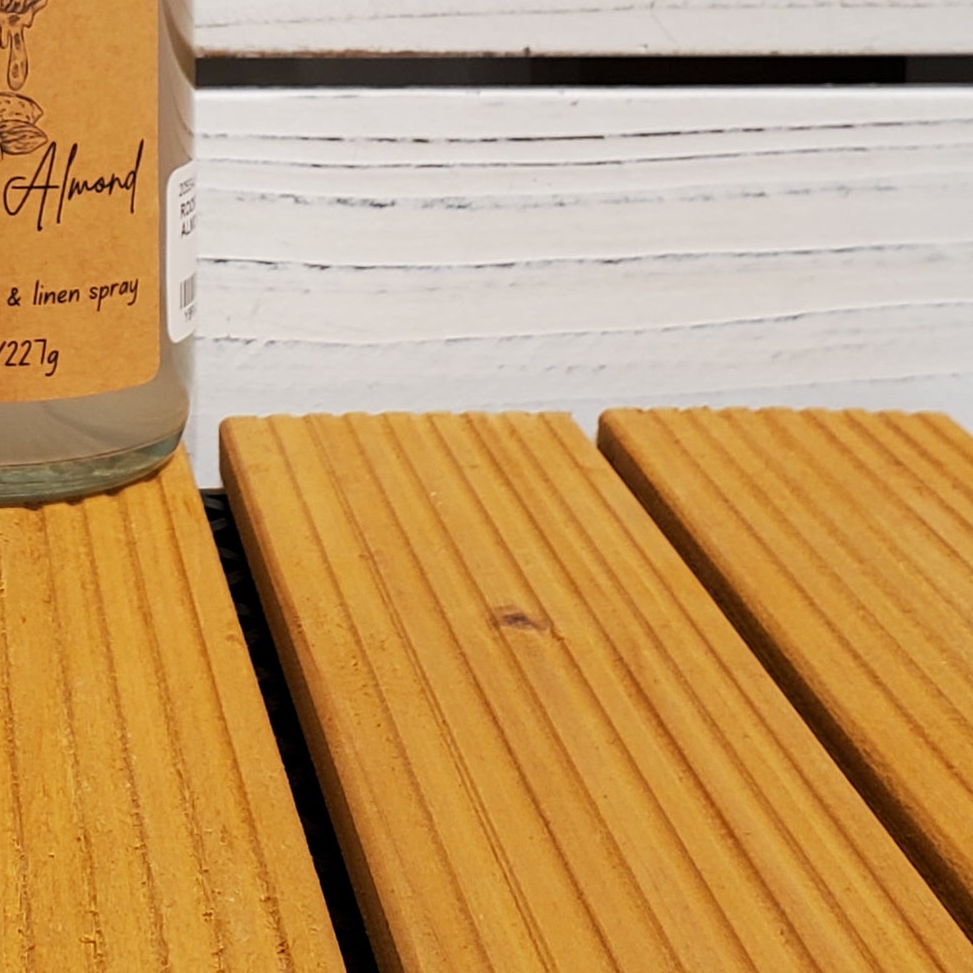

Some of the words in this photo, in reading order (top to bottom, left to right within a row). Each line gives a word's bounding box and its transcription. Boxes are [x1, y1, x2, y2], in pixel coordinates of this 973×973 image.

[3, 139, 144, 231] Almond
[7, 286, 21, 307] &
[32, 280, 80, 306] linen
[89, 278, 139, 312] spray
